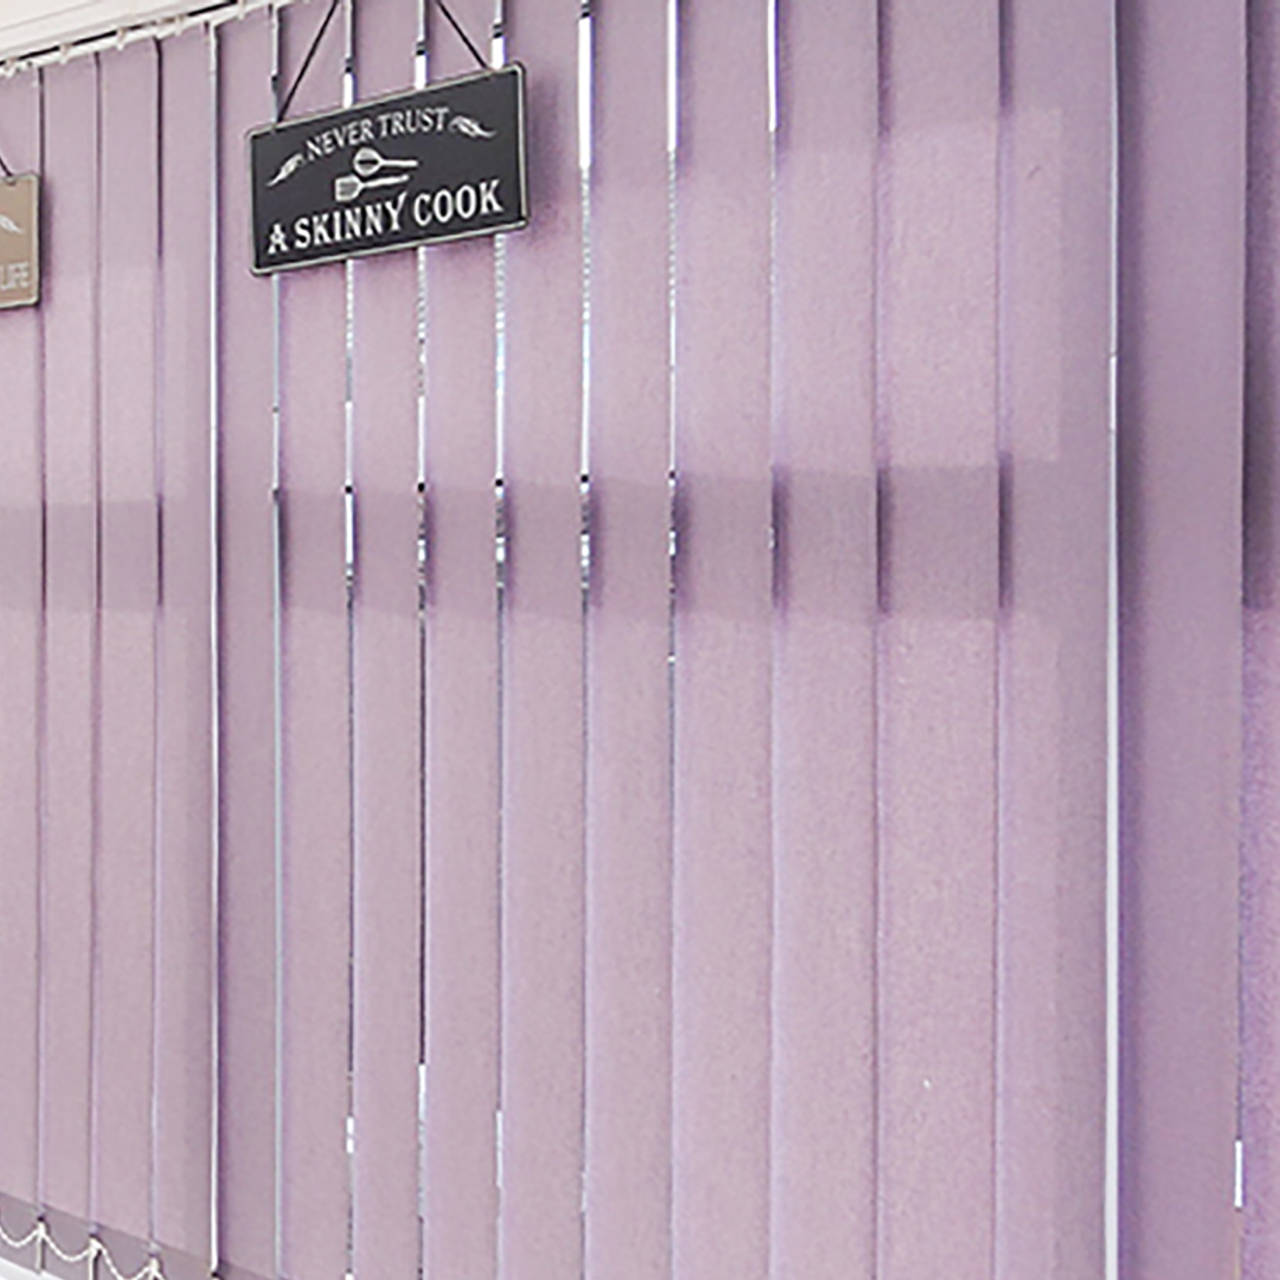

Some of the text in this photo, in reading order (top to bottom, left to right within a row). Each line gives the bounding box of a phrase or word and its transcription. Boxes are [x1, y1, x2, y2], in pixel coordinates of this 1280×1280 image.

[305, 106, 450, 161] NEVER TRUST
[267, 178, 504, 255] A SKINNY COOK
